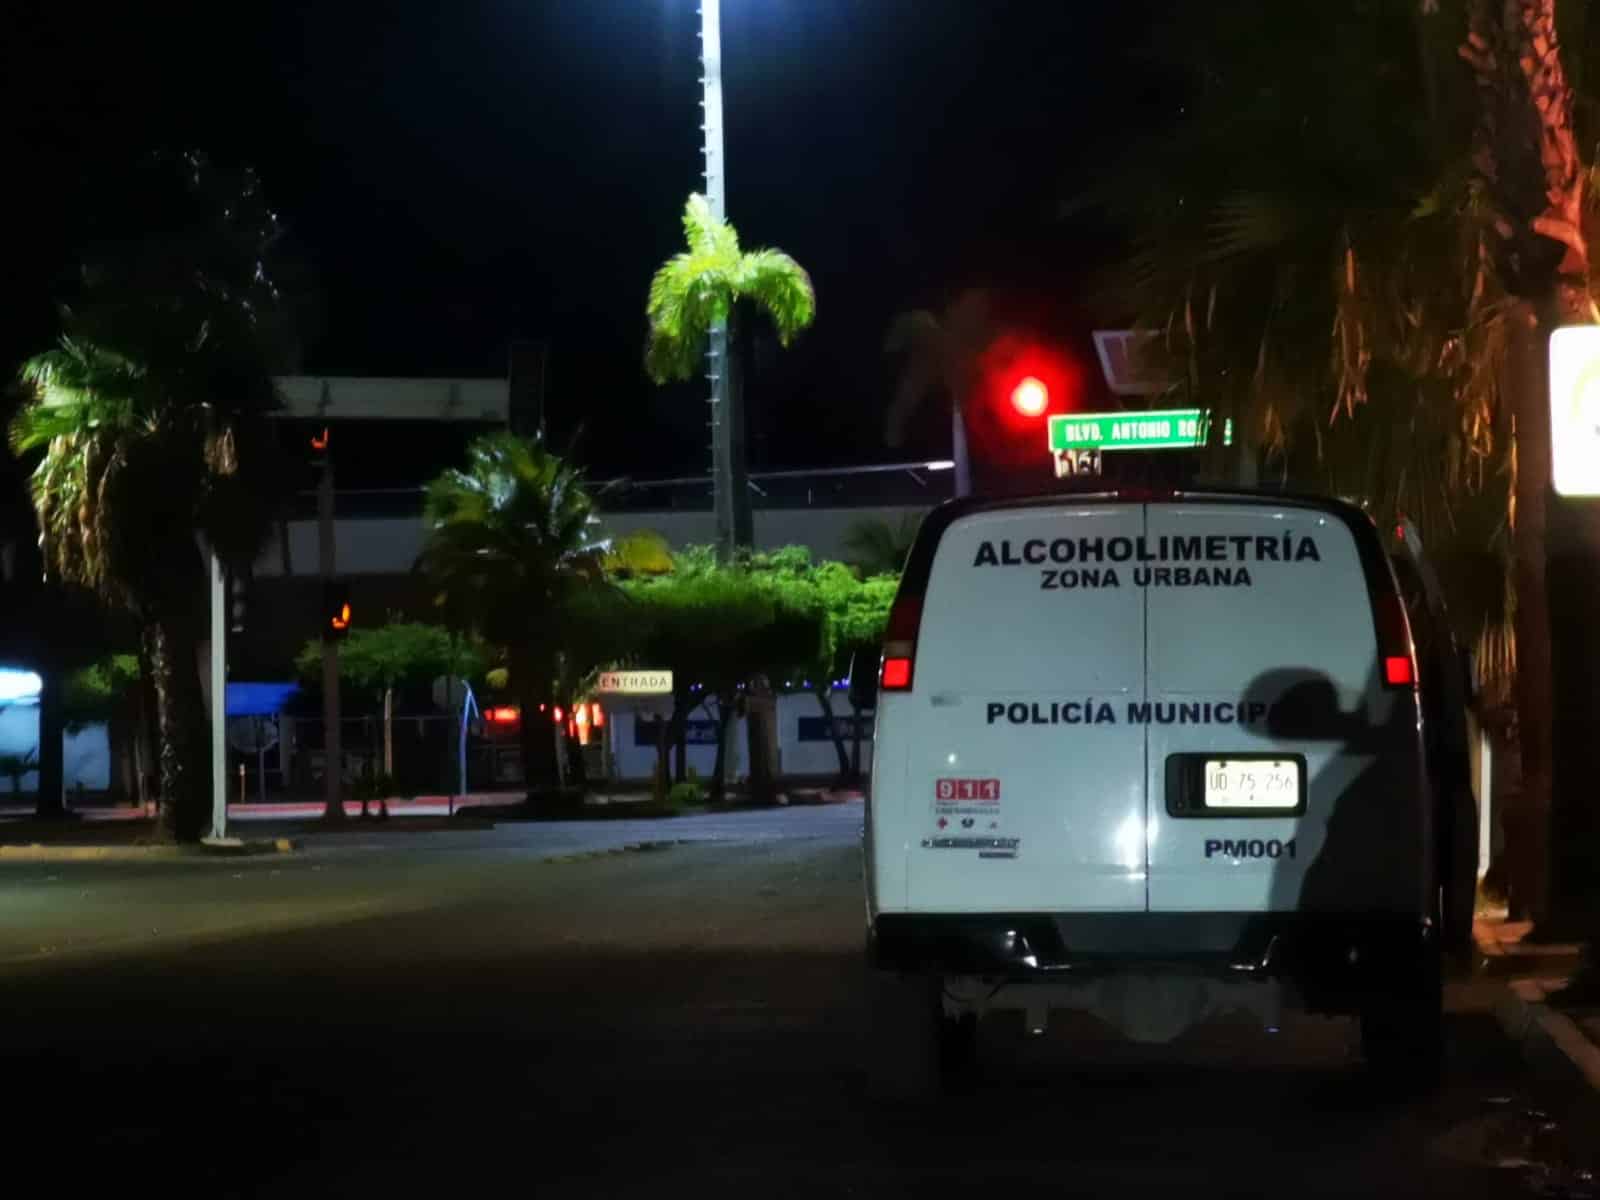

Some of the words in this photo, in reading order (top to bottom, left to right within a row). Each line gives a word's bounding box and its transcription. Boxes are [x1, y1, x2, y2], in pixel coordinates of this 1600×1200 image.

[1065, 423, 1103, 442] BLVD.
[1111, 420, 1171, 440] ANTONIO
[973, 530, 1321, 567] ALCOHOLIMETRÍA
[1040, 569, 1120, 590] ZONA
[1133, 567, 1253, 588] URBANA
[601, 675, 667, 689] ENTRADA
[986, 697, 1115, 725] POLICÍA
[939, 781, 998, 799] 911
[1205, 839, 1297, 859] PM001
